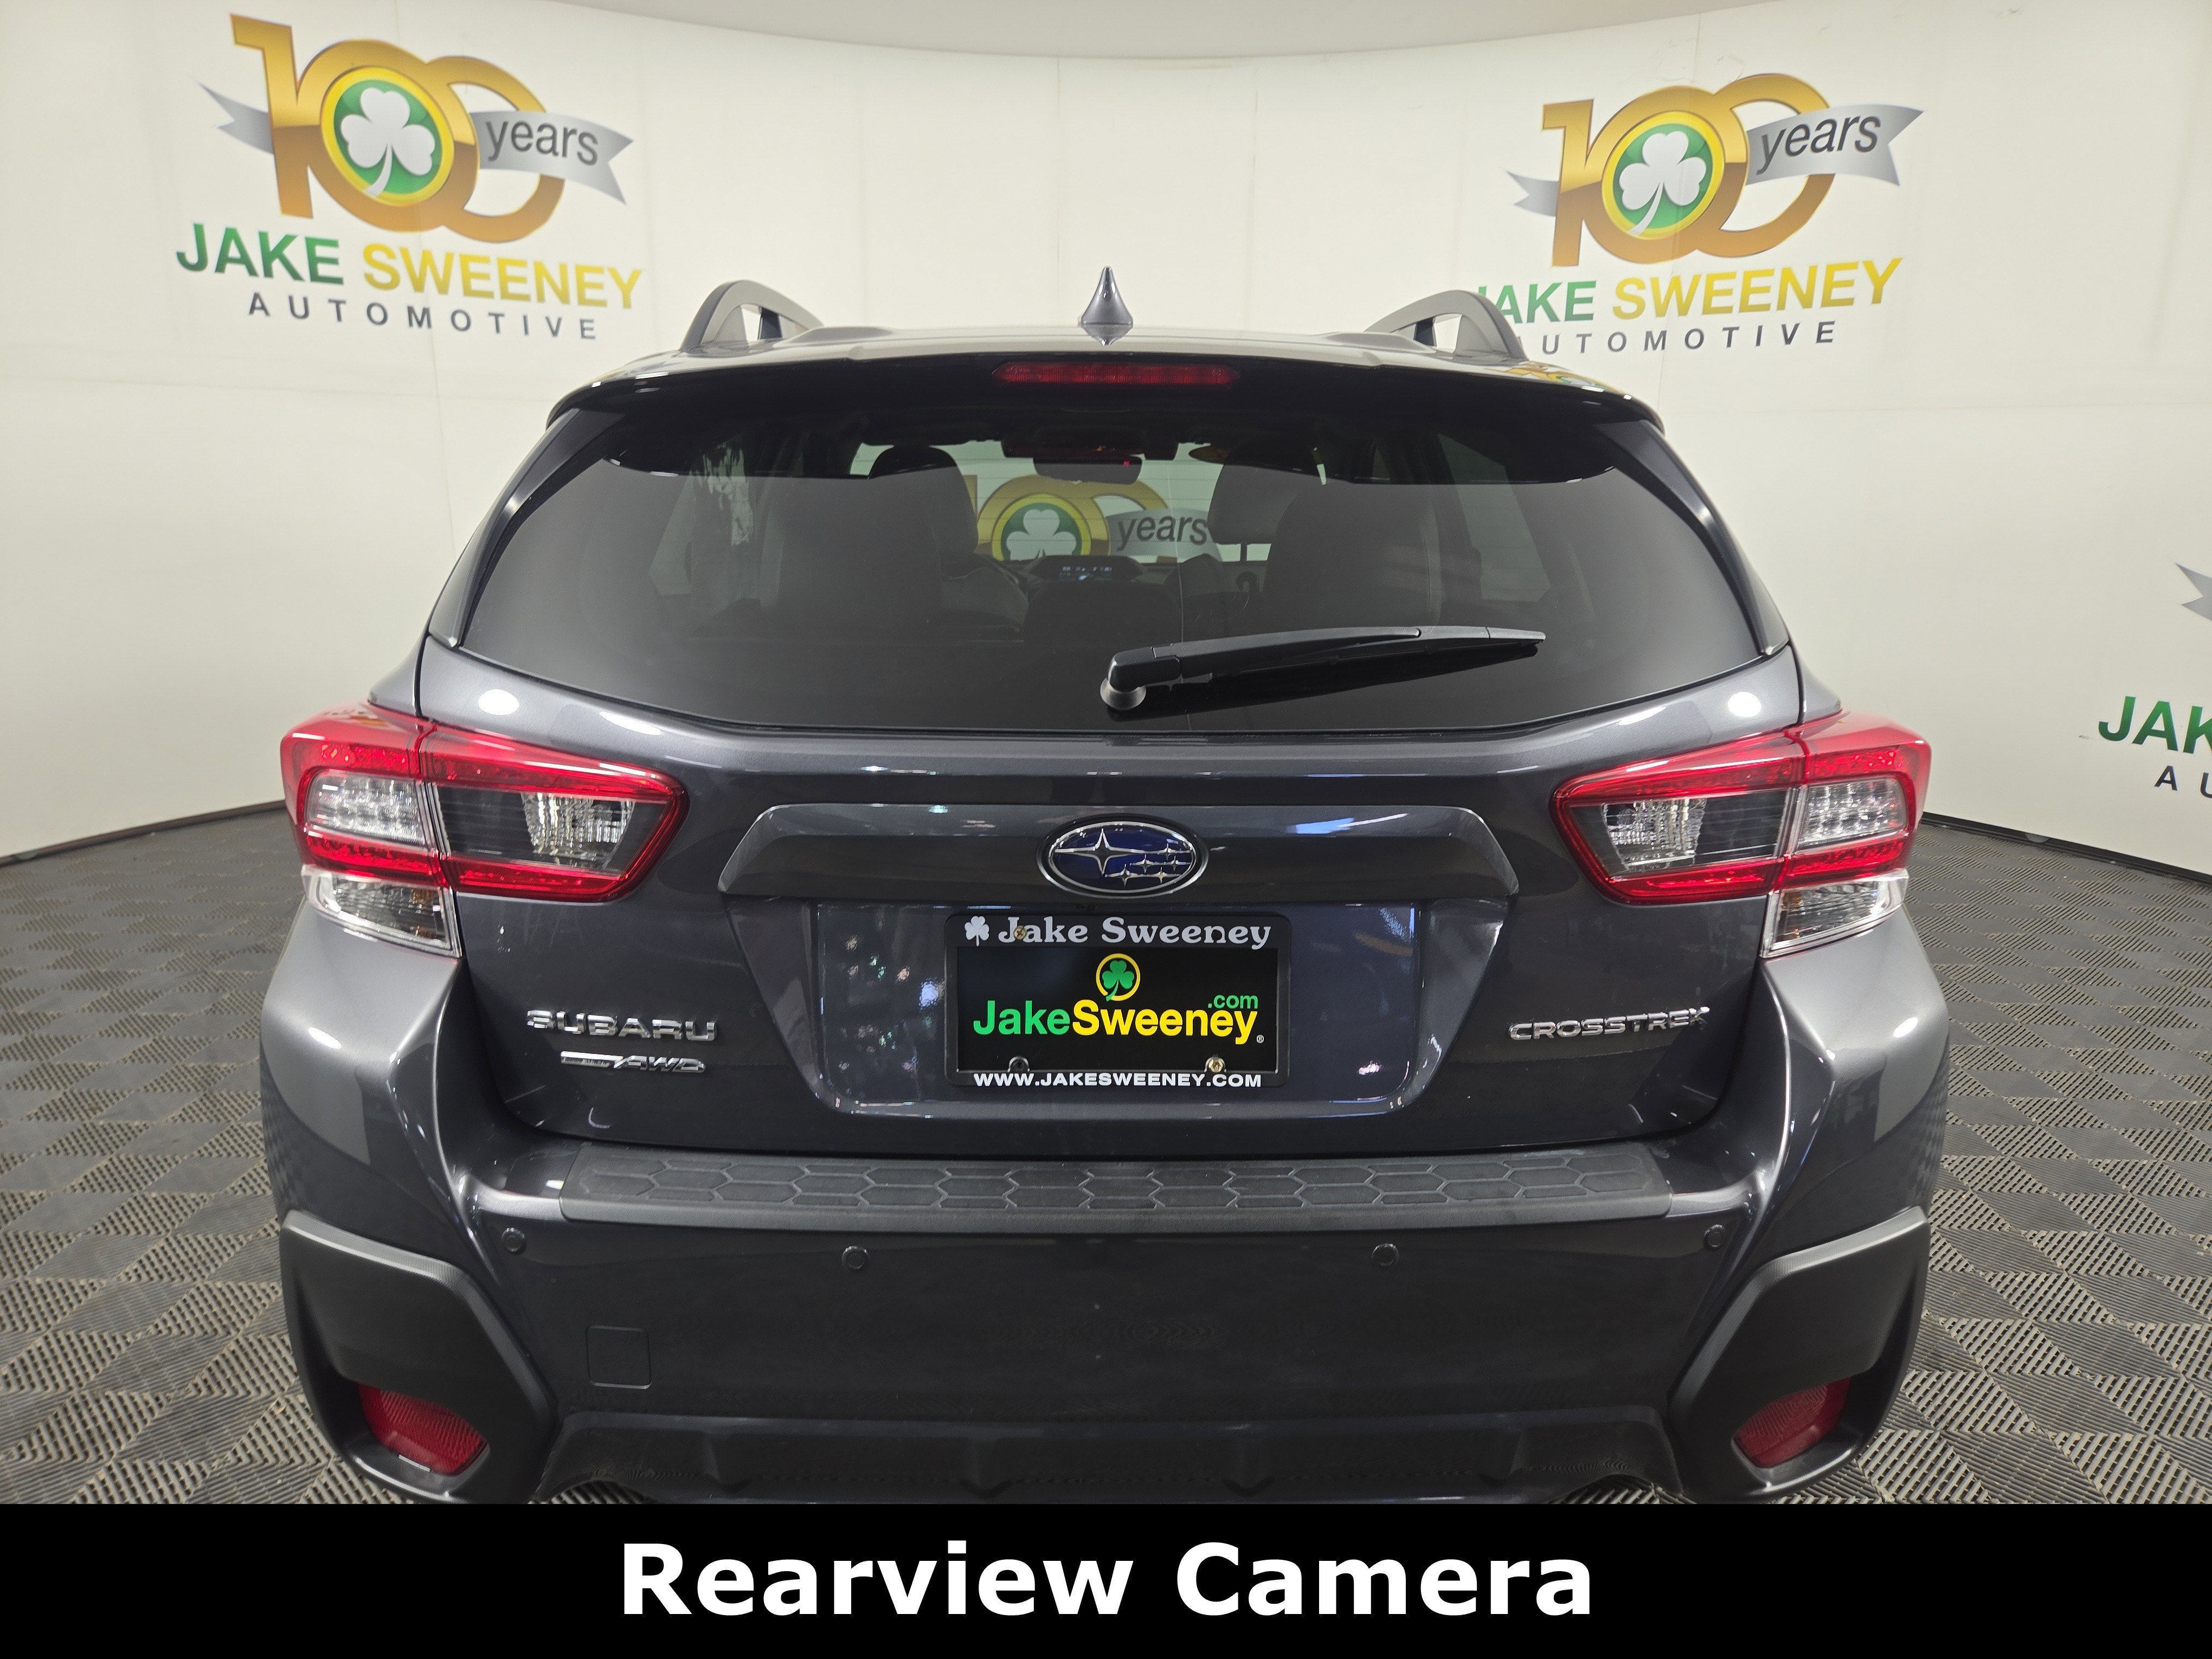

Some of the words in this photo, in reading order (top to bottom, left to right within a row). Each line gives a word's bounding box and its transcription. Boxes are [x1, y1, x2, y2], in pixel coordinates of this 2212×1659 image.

[485, 119, 599, 166] years
[1757, 114, 1881, 176] years
[176, 223, 344, 285] JAKE
[362, 243, 642, 308] SWEENEY
[1478, 280, 1597, 324] AKE
[1612, 257, 1904, 320] SWEENEY
[248, 292, 597, 340] AUTOMOTIVE
[1516, 321, 1836, 355] UTOMOTIVE
[1116, 515, 1208, 551] years
[998, 916, 1089, 944] Jake
[1101, 916, 1271, 950] Sweeney
[527, 1010, 717, 1041] SUBARU
[1509, 1006, 1711, 1041] CROSSTREK
[614, 1055, 705, 1073] AWD
[973, 1073, 1262, 1088] WWW.JAKESWEENEY.COM
